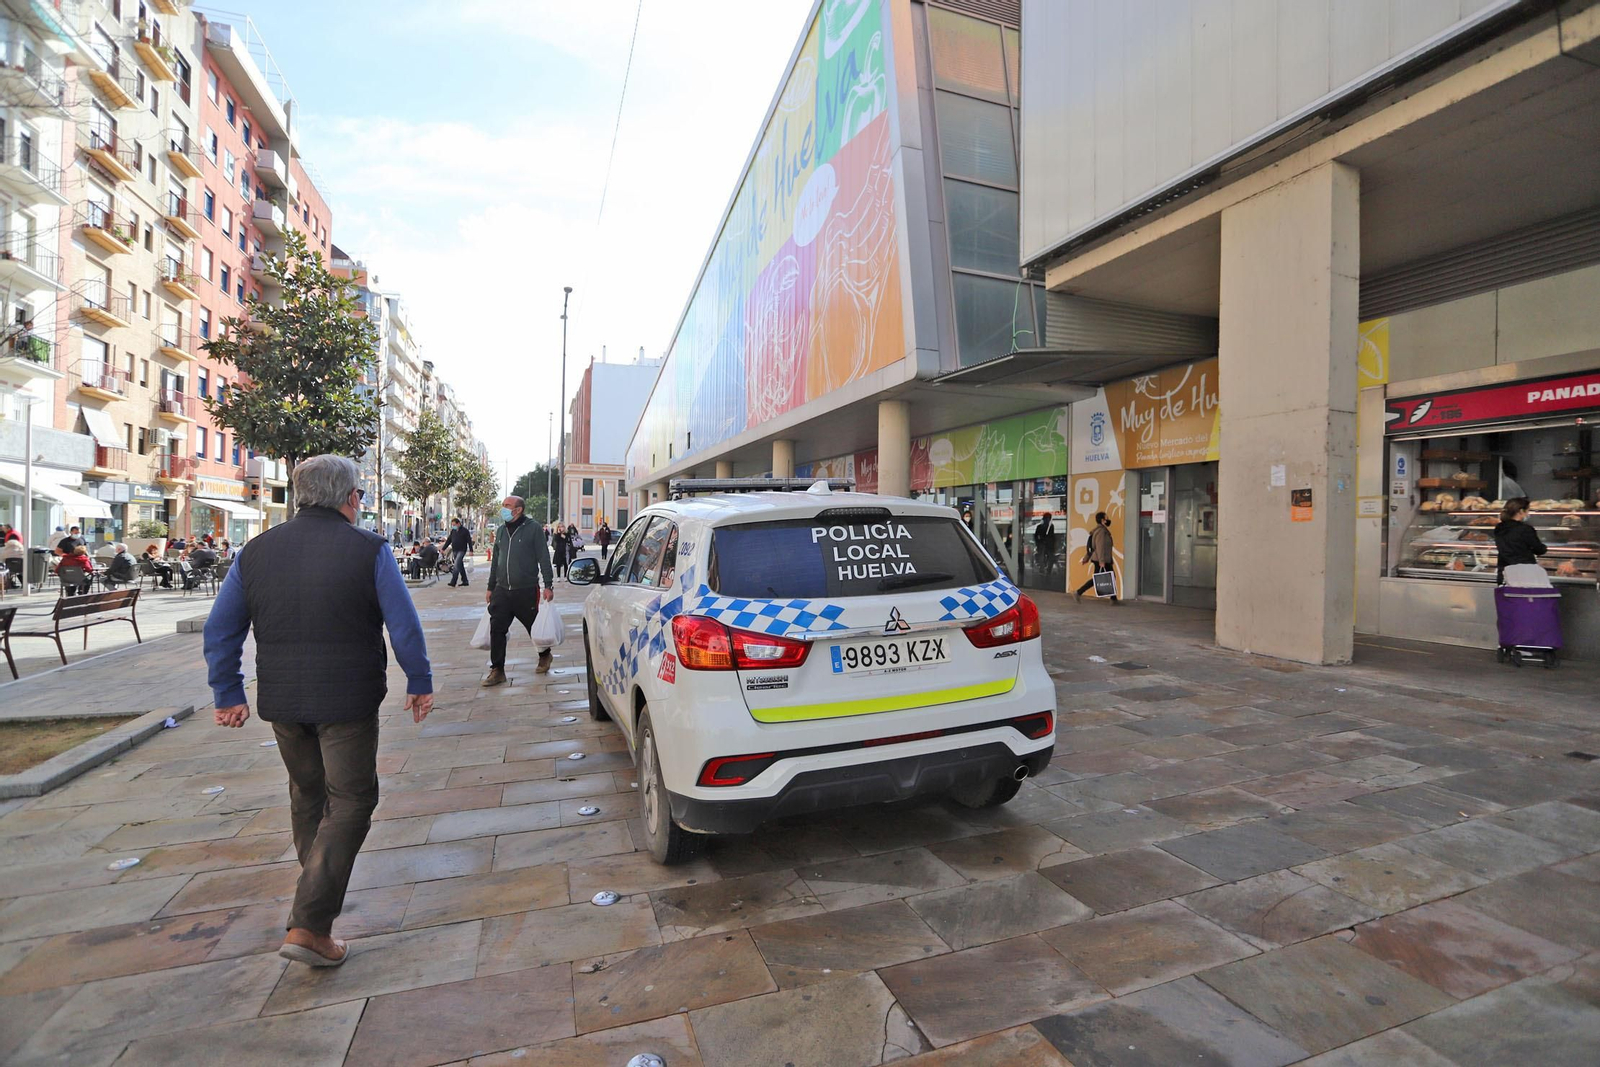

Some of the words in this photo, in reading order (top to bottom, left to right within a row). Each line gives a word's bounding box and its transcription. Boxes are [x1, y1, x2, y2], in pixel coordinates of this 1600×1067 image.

[774, 48, 862, 222] Huelva
[1527, 384, 1600, 404] PANAD
[1120, 400, 1155, 443] Muy
[1160, 390, 1186, 421] de
[1160, 436, 1193, 449] Mercado
[1085, 452, 1110, 462] HUELVA
[860, 458, 873, 483] Muy
[811, 521, 913, 544] POLICÍA
[833, 543, 910, 562] LOCAL
[837, 562, 917, 581] HUELVA
[845, 643, 900, 669] 9893
[906, 638, 946, 663] KZX
[993, 649, 1018, 659] ASX
[666, 659, 675, 672] 112
[834, 661, 840, 669] E
